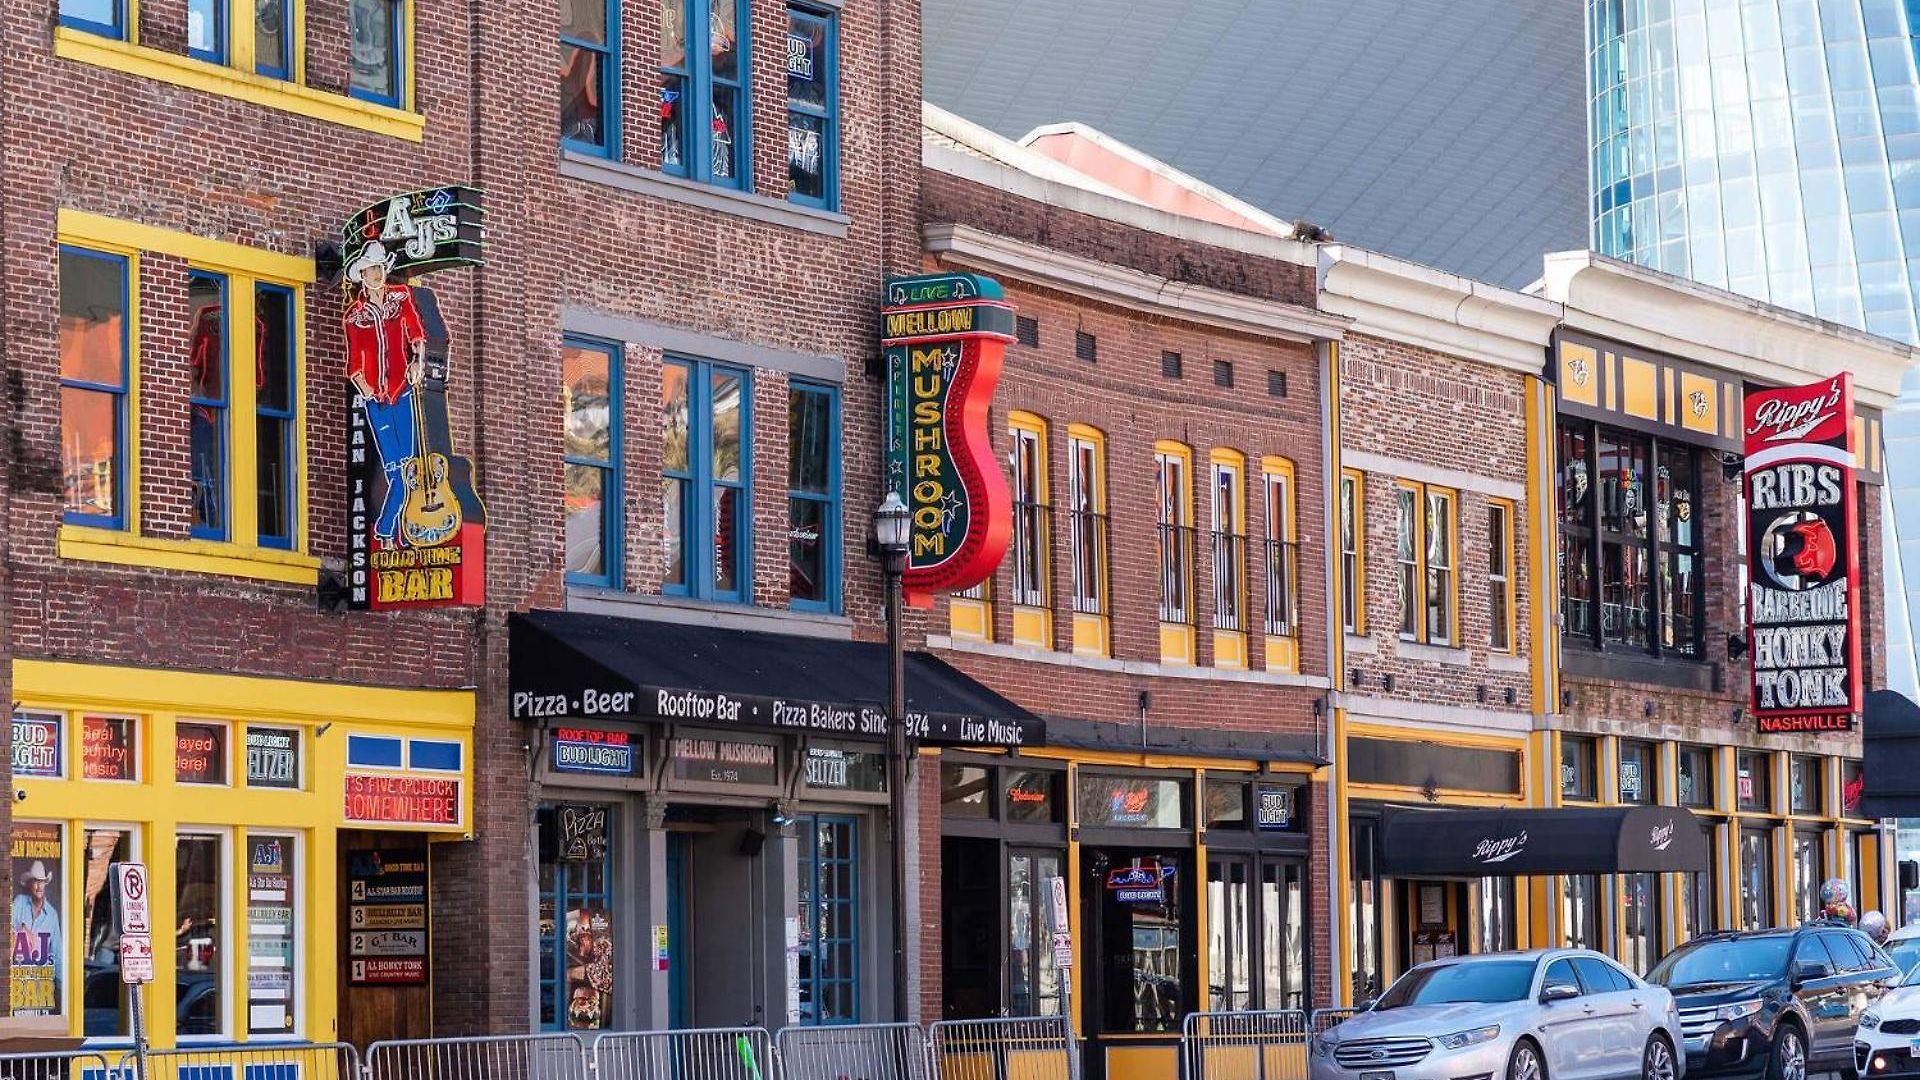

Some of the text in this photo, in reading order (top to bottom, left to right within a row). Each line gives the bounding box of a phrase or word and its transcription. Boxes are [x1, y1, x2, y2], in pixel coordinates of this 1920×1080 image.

[787, 37, 805, 56] UD
[787, 57, 810, 76] GHT
[911, 284, 949, 300] LIVE
[887, 306, 974, 337] MELLOW
[1746, 379, 1842, 439] Rippy's
[351, 394, 366, 464] ALAN
[911, 347, 945, 557] MUSHROOM
[1751, 463, 1841, 510] RIBS
[350, 479, 367, 602] JACKSON
[378, 567, 454, 603] BAR
[1753, 624, 1847, 669] HONKY
[1757, 667, 1849, 709] TONK
[513, 688, 635, 718] Pizza Beer
[657, 689, 742, 721] Rooftop Bar
[773, 700, 930, 738] Pizza Bakers Sinc 974
[960, 717, 1024, 744] Live Music
[1760, 714, 1849, 731] NASHVILLE
[11, 723, 48, 746] BUD
[176, 736, 213, 752] layed
[557, 727, 629, 744] ROOFTOP BAR
[82, 743, 127, 762] ountry
[247, 748, 295, 781] ELTZER
[559, 745, 629, 768] BUD LIGHT
[675, 739, 775, 765] MELLOW MUSHROOM
[806, 758, 847, 785] SELTZER
[345, 776, 363, 792] T'S
[368, 777, 396, 794] FIVE
[344, 793, 455, 821] SOMEWHERE
[1262, 794, 1282, 809] BUD
[1259, 808, 1286, 824] LIGHT
[1472, 829, 1528, 859] Rippy's
[354, 882, 363, 898] 4
[355, 909, 363, 924] 3
[355, 936, 363, 950] 2
[355, 961, 362, 977] 1
